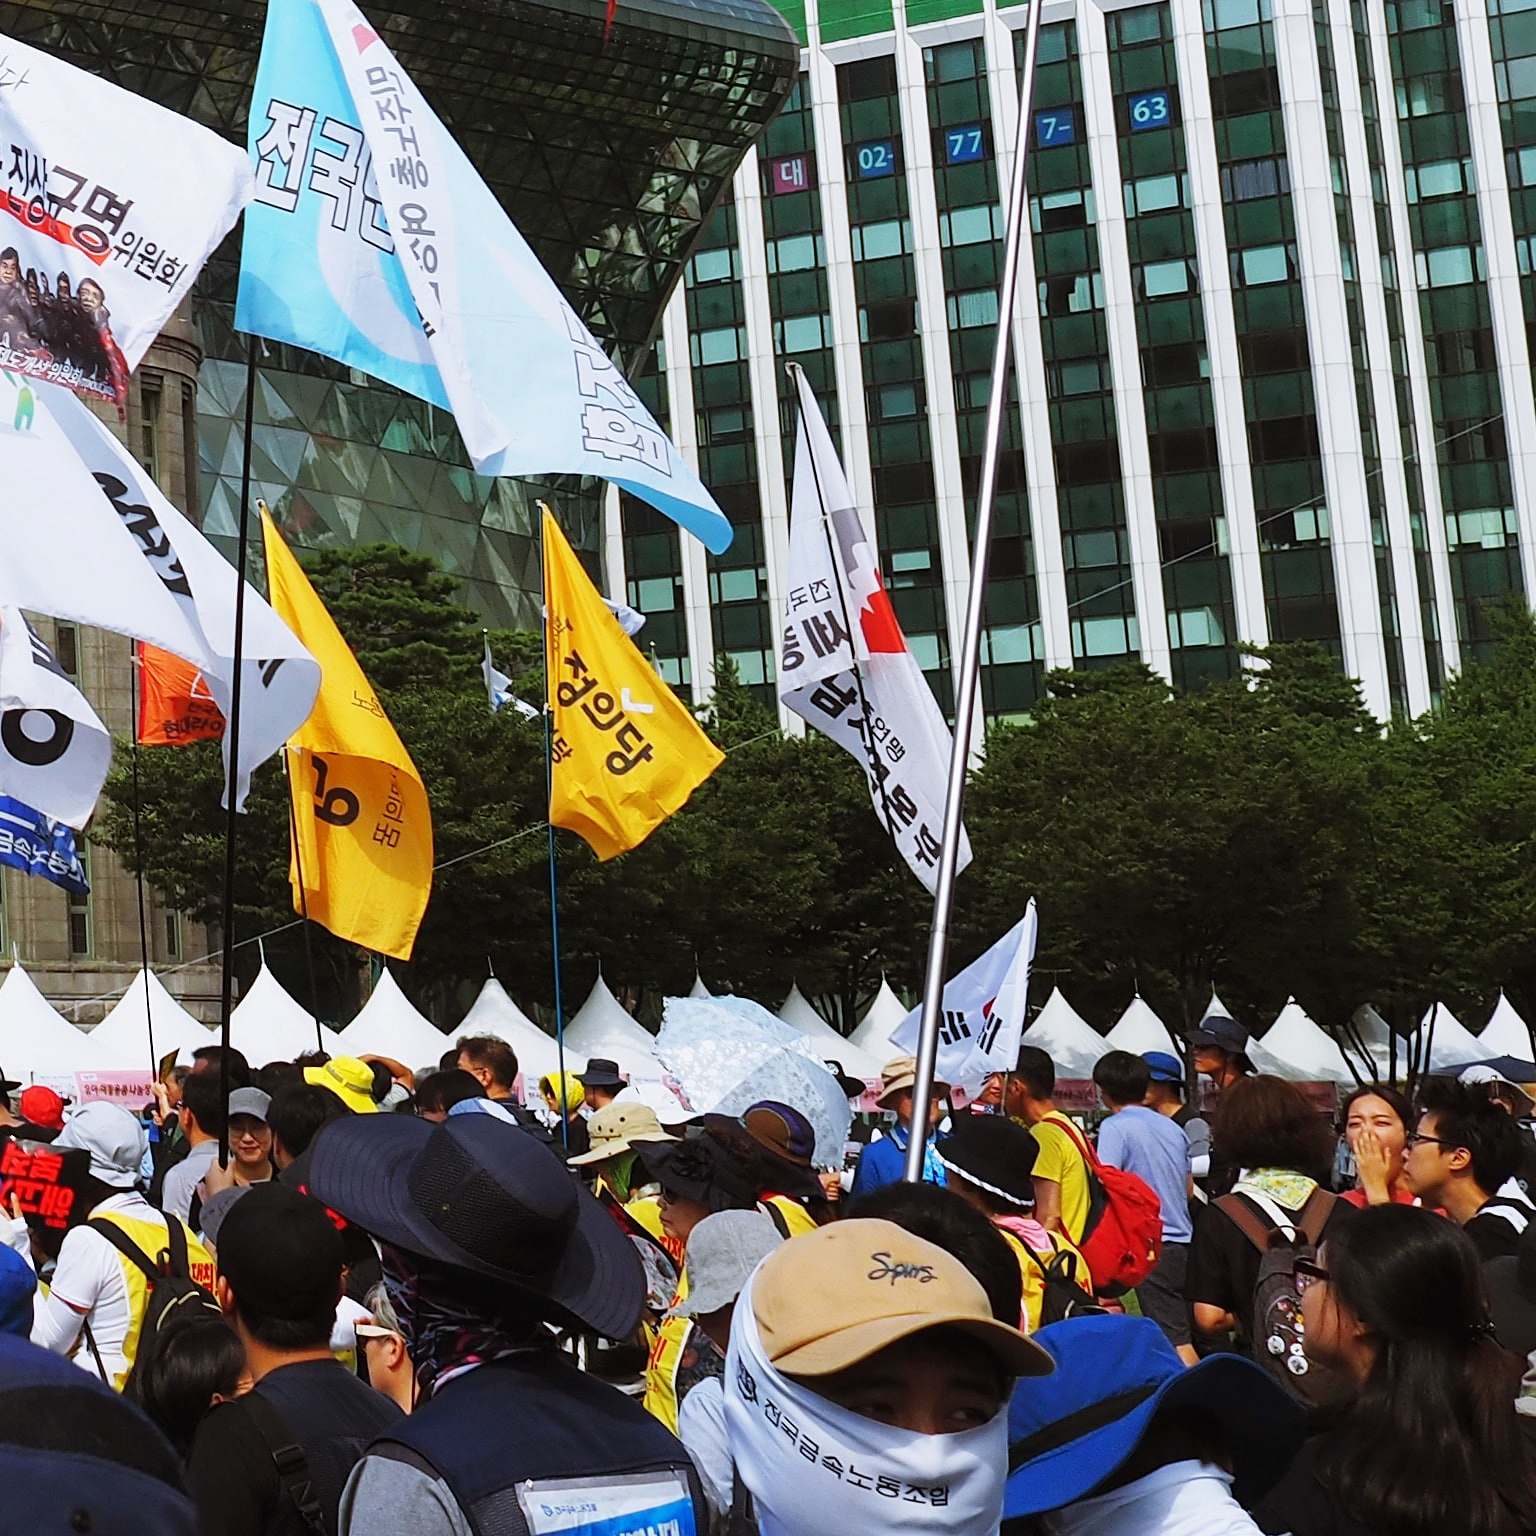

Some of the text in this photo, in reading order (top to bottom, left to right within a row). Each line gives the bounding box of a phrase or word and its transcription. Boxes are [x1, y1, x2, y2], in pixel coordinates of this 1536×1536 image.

[858, 144, 894, 169] 02-
[949, 130, 981, 156] 77
[1133, 97, 1167, 122] 63
[556, 648, 655, 776] 정의당
[763, 1397, 950, 1508] 전국금속노동조합
